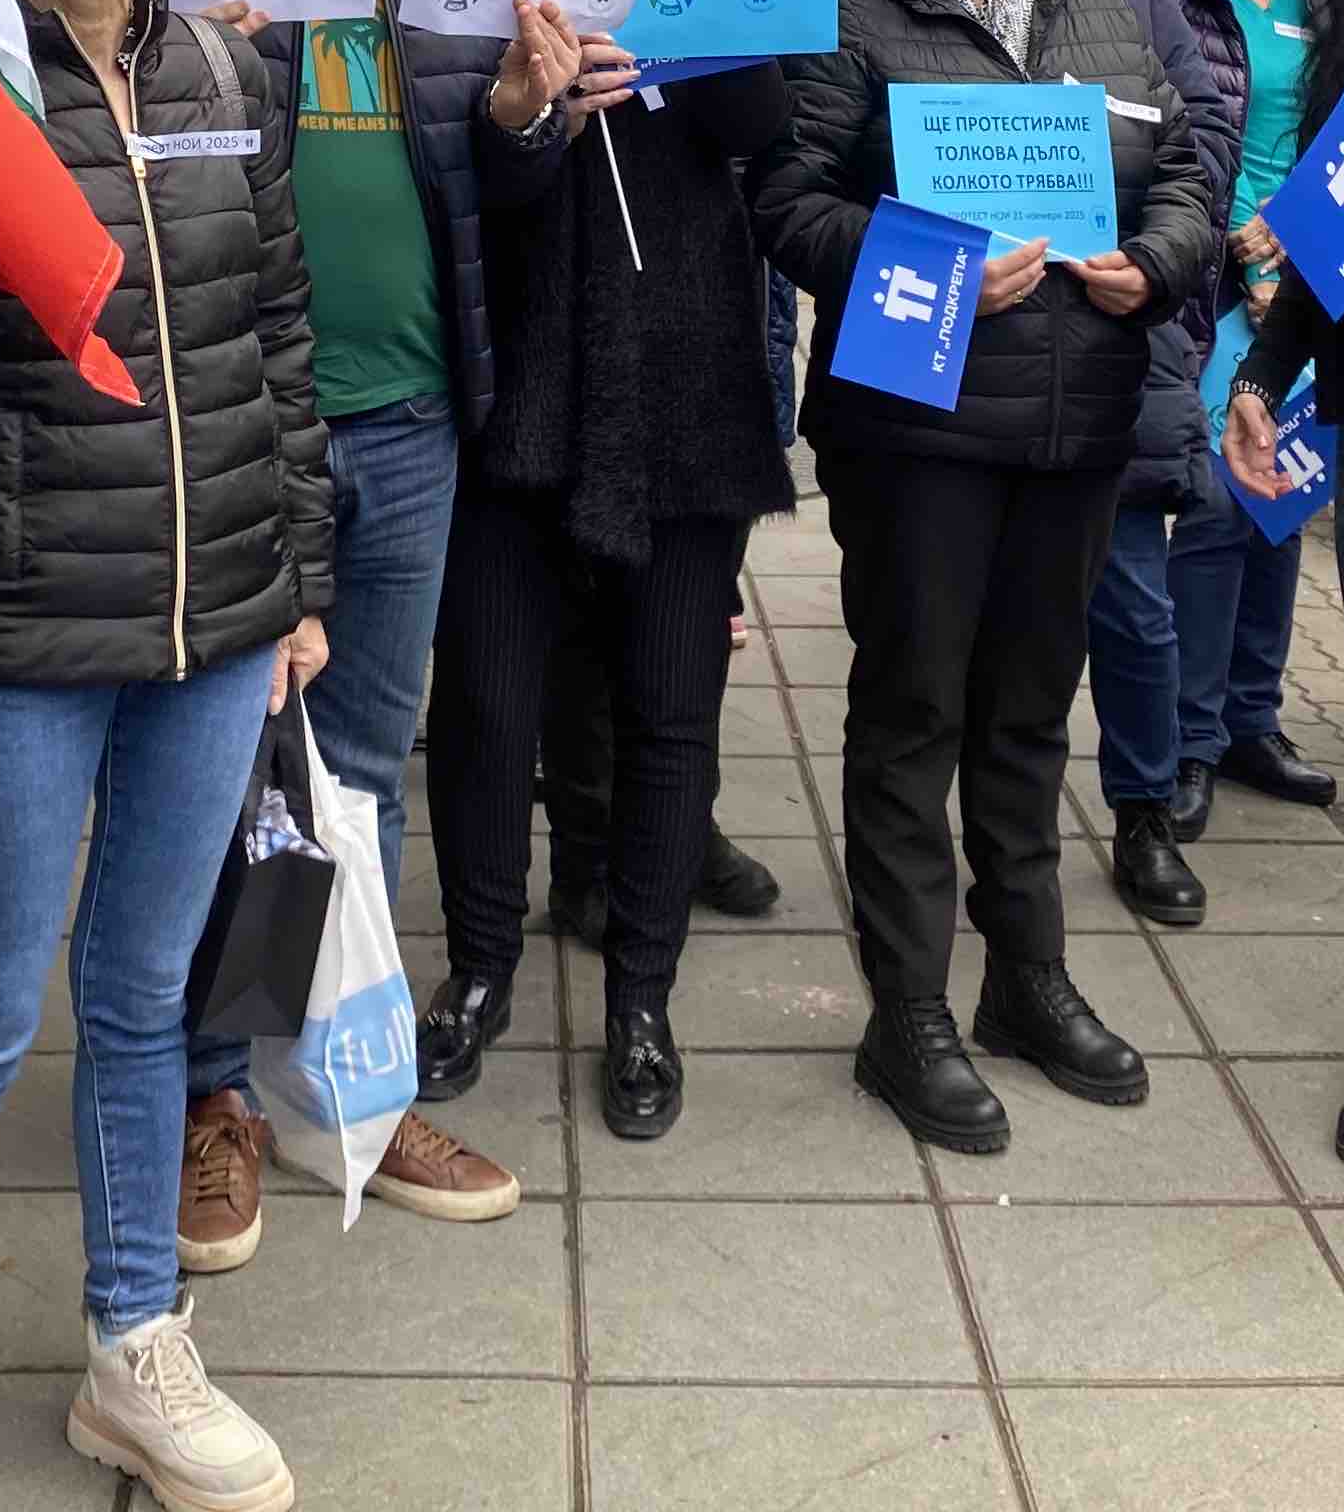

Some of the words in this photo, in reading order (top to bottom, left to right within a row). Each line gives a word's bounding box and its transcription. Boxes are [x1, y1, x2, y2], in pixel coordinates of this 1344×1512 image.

[923, 116, 951, 134] ЩЕ
[956, 115, 1091, 133] ПРОТЕСТИРАМЕ
[173, 137, 201, 152] НОИ
[205, 135, 239, 150] 2025
[935, 145, 1018, 161] ТОЛКОВА
[1023, 145, 1086, 165] ДЪЛГО,
[932, 174, 1012, 190] КОЛКОТО
[1016, 173, 1094, 190] ТРЯБВА!!!
[931, 350, 947, 373] КТ
